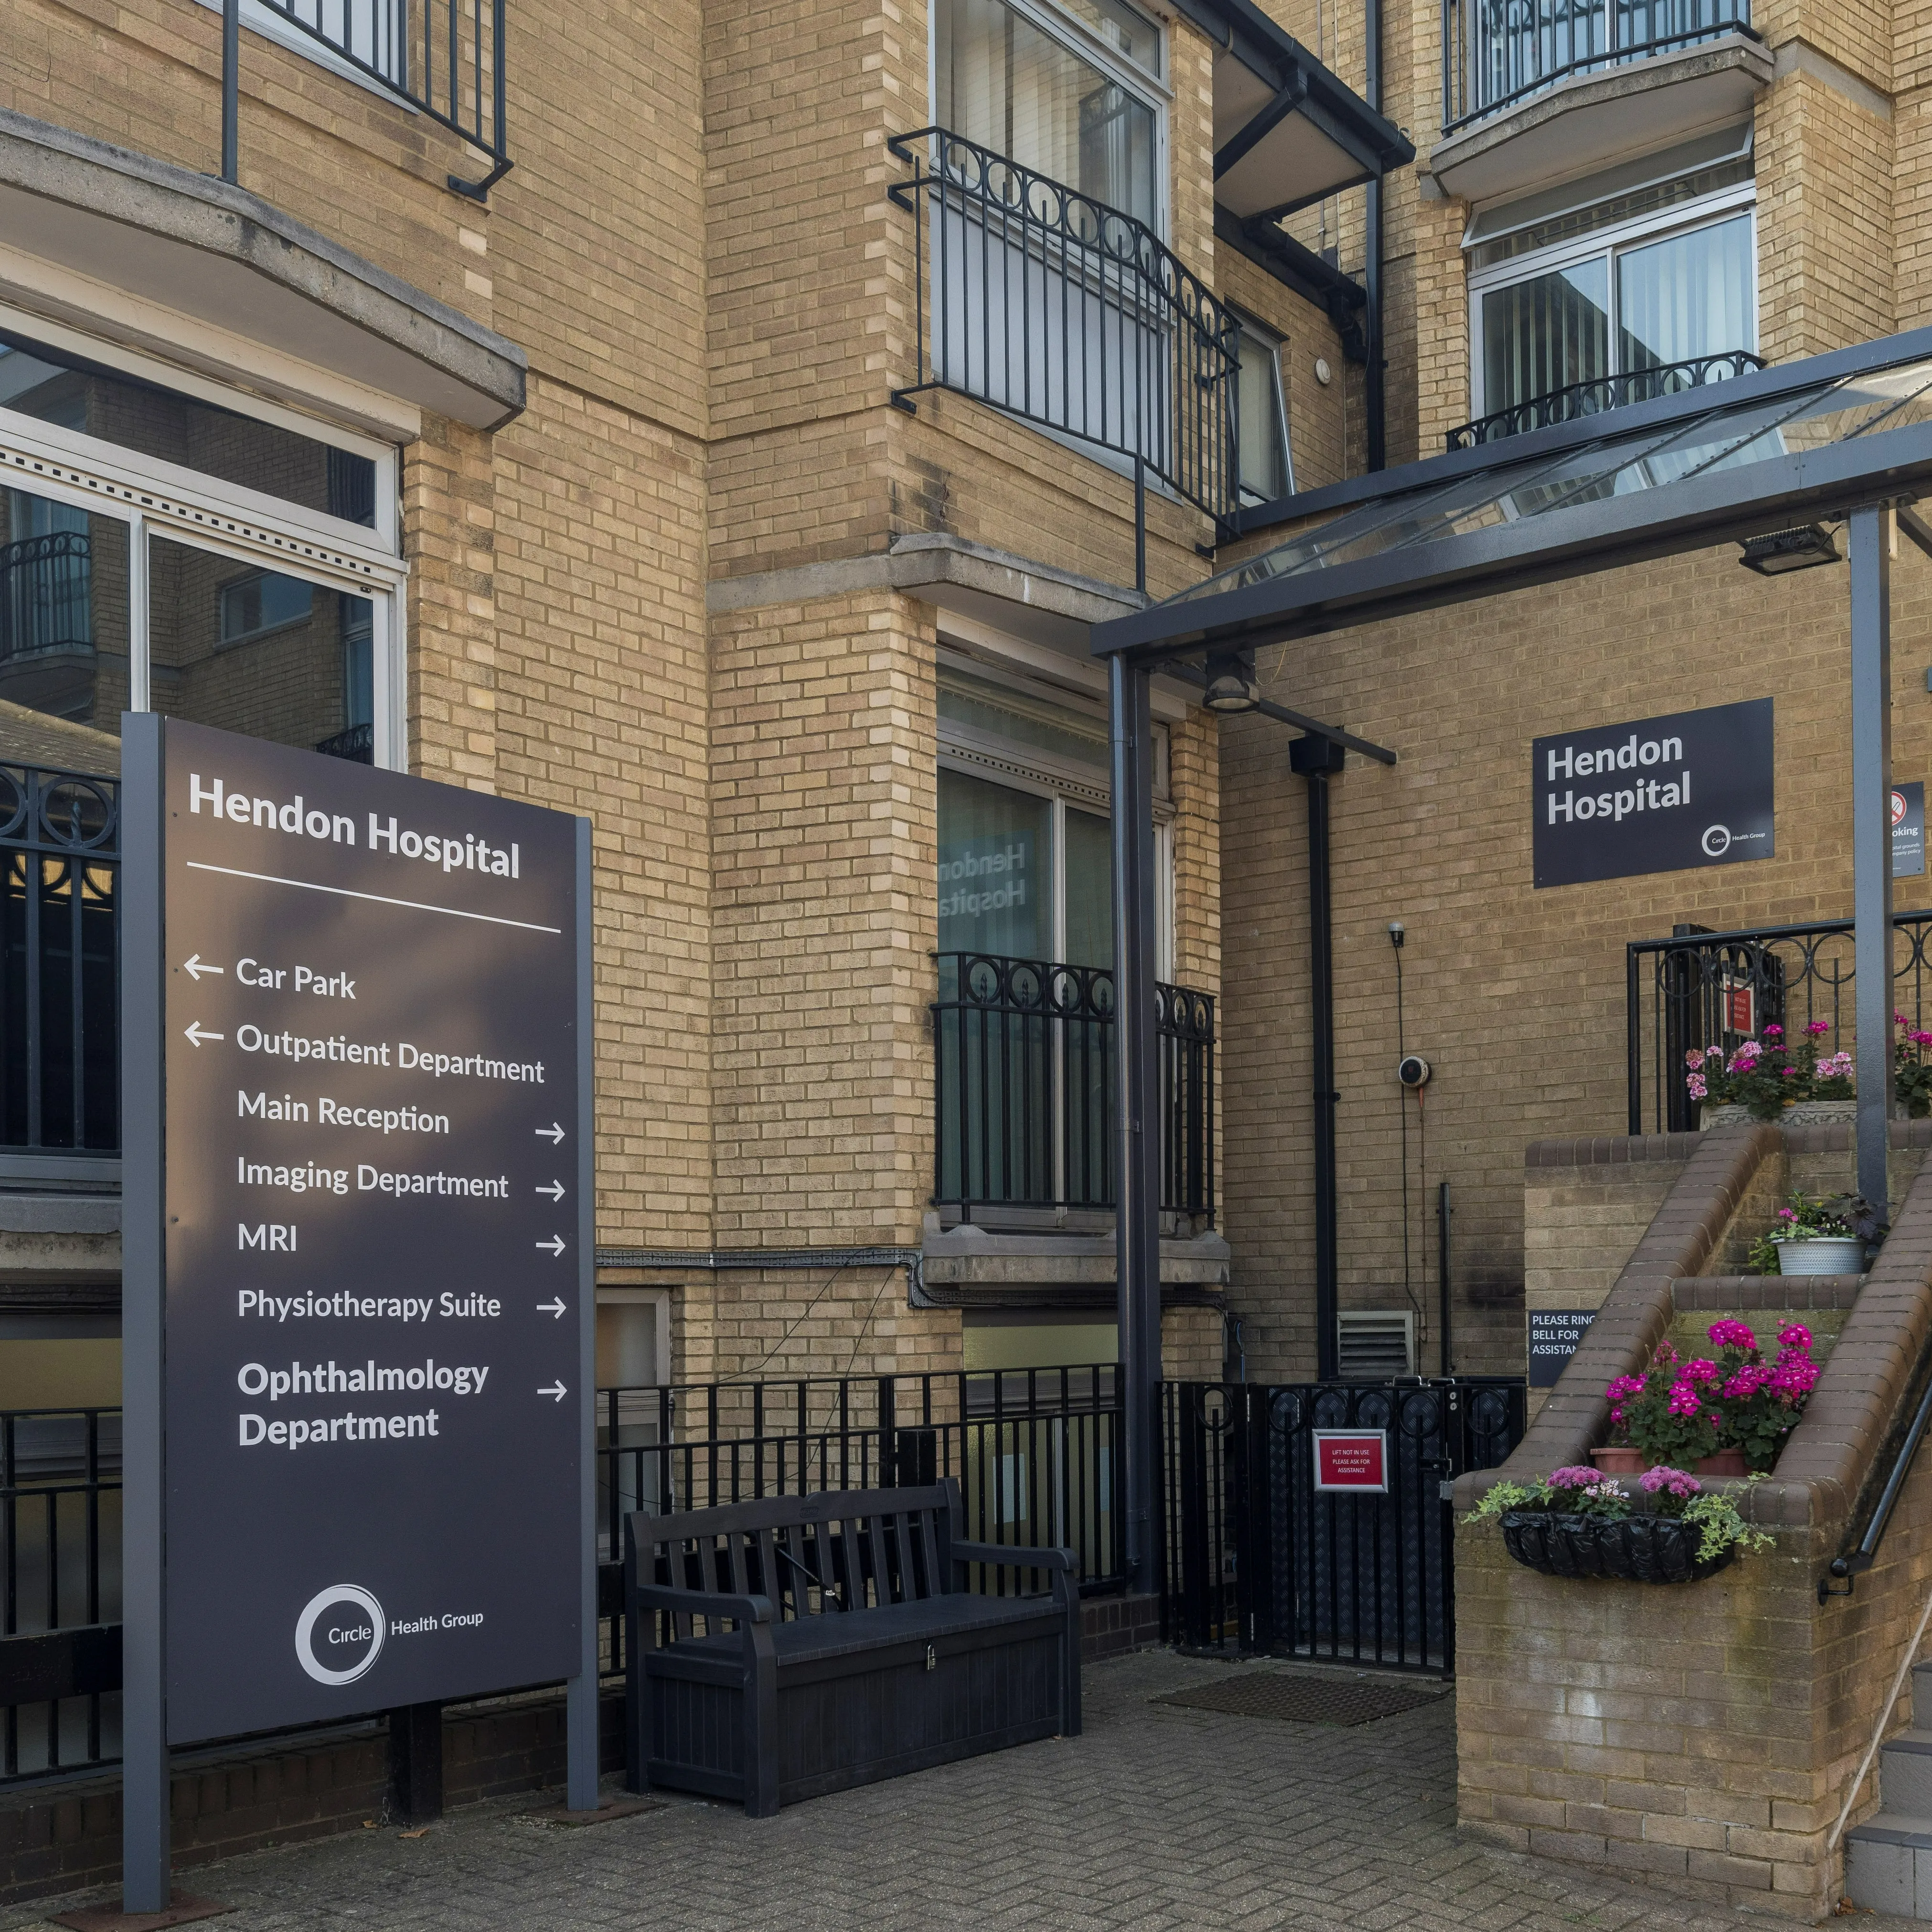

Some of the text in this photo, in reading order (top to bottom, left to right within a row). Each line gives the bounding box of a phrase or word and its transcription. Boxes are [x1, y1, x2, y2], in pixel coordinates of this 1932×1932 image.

[1548, 734, 1682, 781] Hendon
[1548, 771, 1690, 825] Hospital
[190, 773, 519, 879] Hendon Hospital
[1892, 826, 1918, 837] oking
[236, 958, 356, 999] Car Park
[236, 1024, 545, 1084] Outpatient Department
[238, 1090, 449, 1134] Main Reception
[238, 1157, 509, 1198] Imaging Department
[238, 1223, 297, 1251] MRI
[238, 1289, 501, 1322] Physiotherapy Suite
[1533, 1315, 1569, 1325] PLEASE
[1532, 1345, 1576, 1354] ASSISTA
[1533, 1330, 1579, 1340] BELL FOR
[238, 1359, 489, 1401] Ophthalmology
[239, 1409, 439, 1450] Department
[328, 1612, 484, 1644] Circle Health Group
